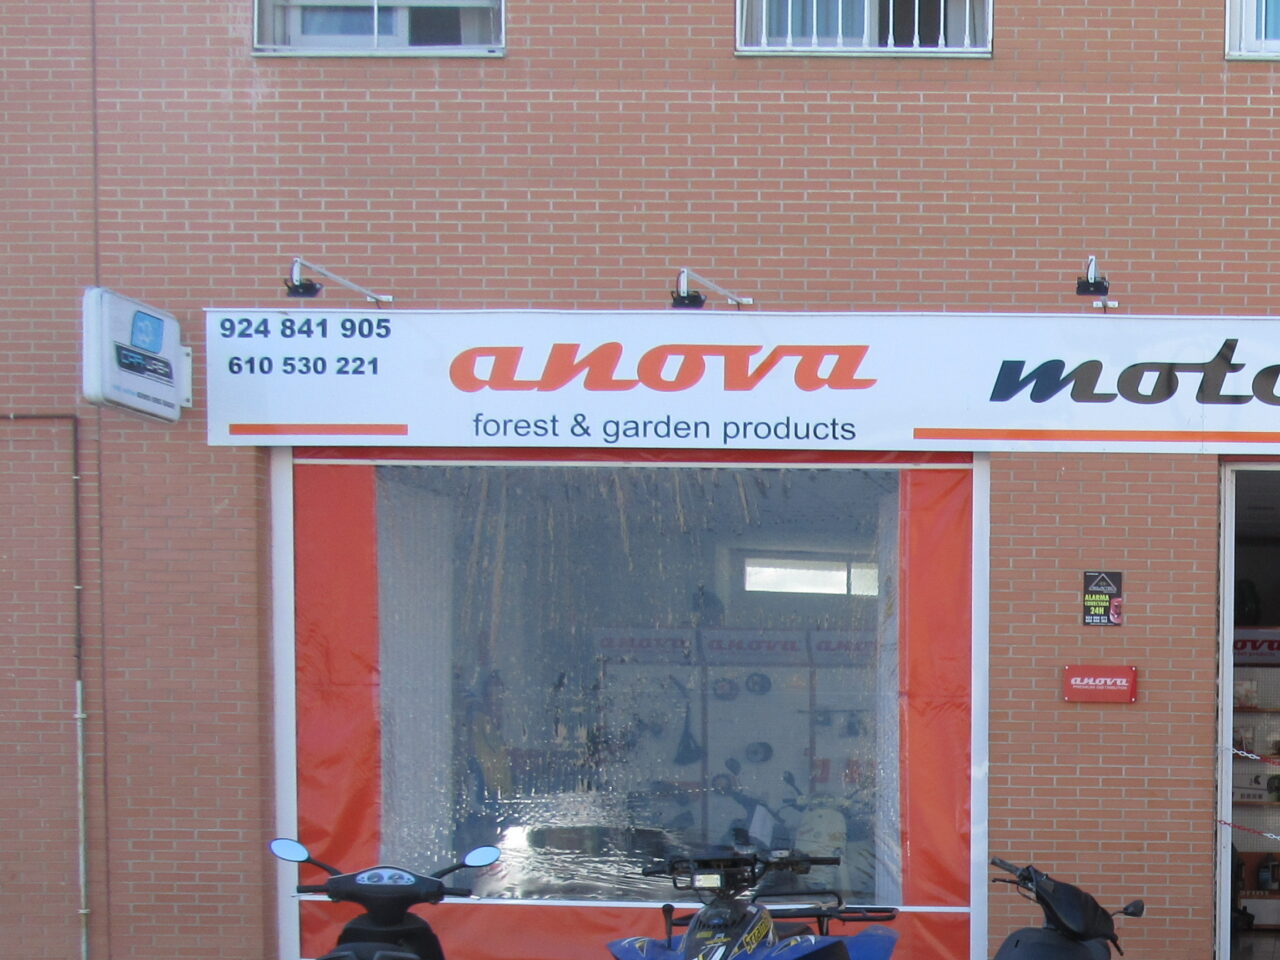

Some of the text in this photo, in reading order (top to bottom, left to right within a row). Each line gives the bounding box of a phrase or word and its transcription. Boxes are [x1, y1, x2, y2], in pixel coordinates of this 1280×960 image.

[221, 319, 391, 339] 924 841 905
[228, 356, 378, 375] 610 530 221
[450, 342, 877, 392] anova
[474, 413, 857, 445] forest & garden products
[1070, 677, 1129, 686] anova
